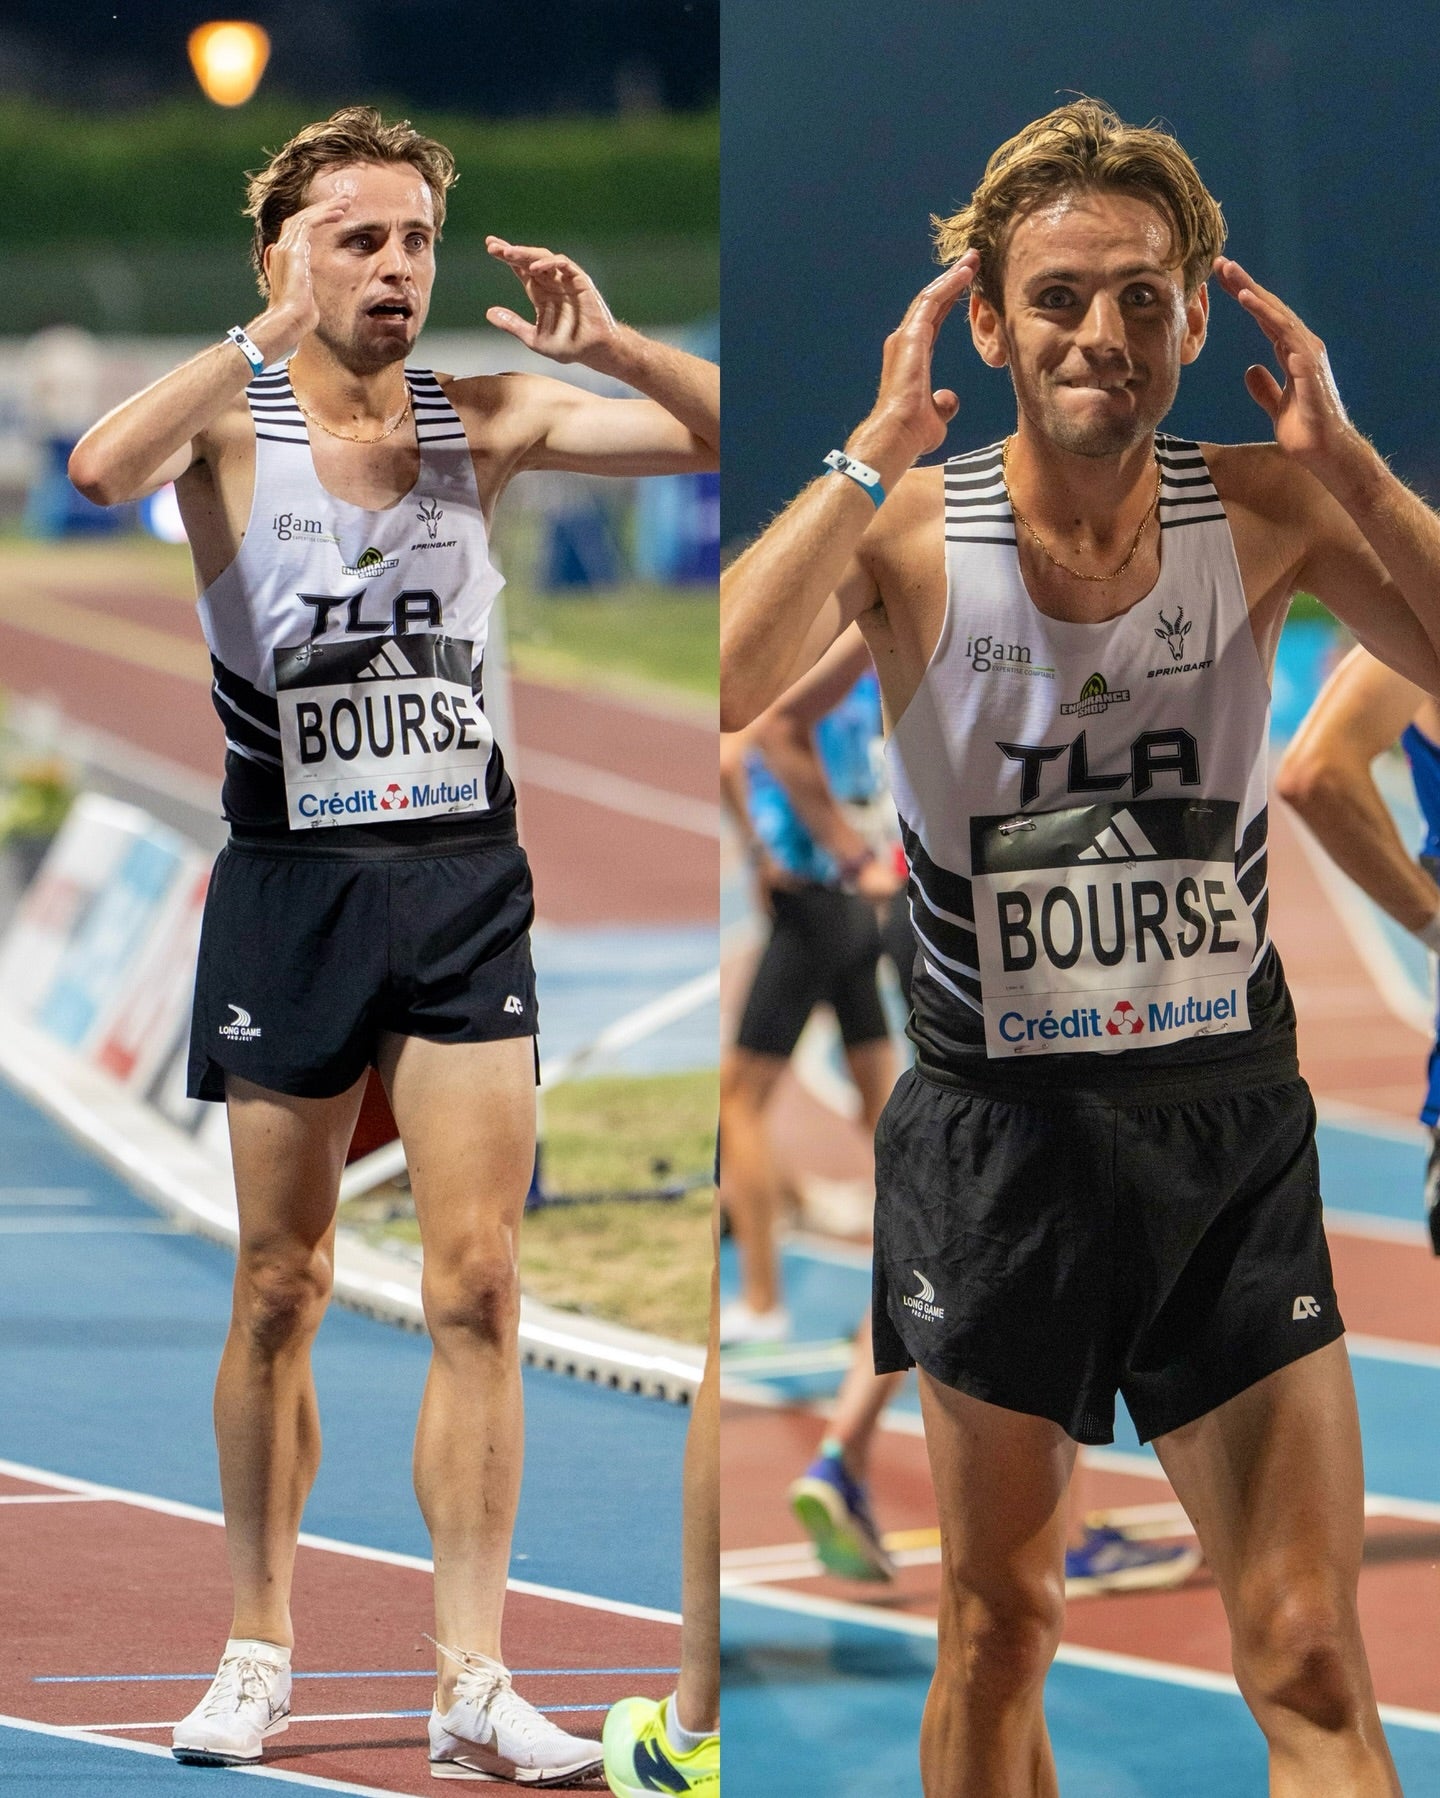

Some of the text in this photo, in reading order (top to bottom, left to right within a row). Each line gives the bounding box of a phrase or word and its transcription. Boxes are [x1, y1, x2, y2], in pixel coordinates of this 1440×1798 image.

[272, 513, 322, 541] igam
[411, 540, 458, 551] SPRINGART
[358, 568, 385, 580] SHOP
[296, 588, 443, 640] TLA
[965, 636, 1032, 673] igam
[991, 665, 1056, 680] EXPERTISE COMPTABLE
[1147, 660, 1213, 678] SPRINGART
[1060, 689, 1130, 715] ENDURANCE
[1078, 702, 1108, 718] SHOP
[296, 691, 481, 764] BOURSE
[995, 727, 1201, 808] TLA
[298, 778, 478, 818] Crédit Mutuel
[996, 876, 1241, 972] BOURSE
[999, 989, 1237, 1043] Crédit Mutuel
[219, 1026, 262, 1037] LONG GAME
[903, 1295, 945, 1319] LONG GAME
[911, 1308, 935, 1323] PROJECT
